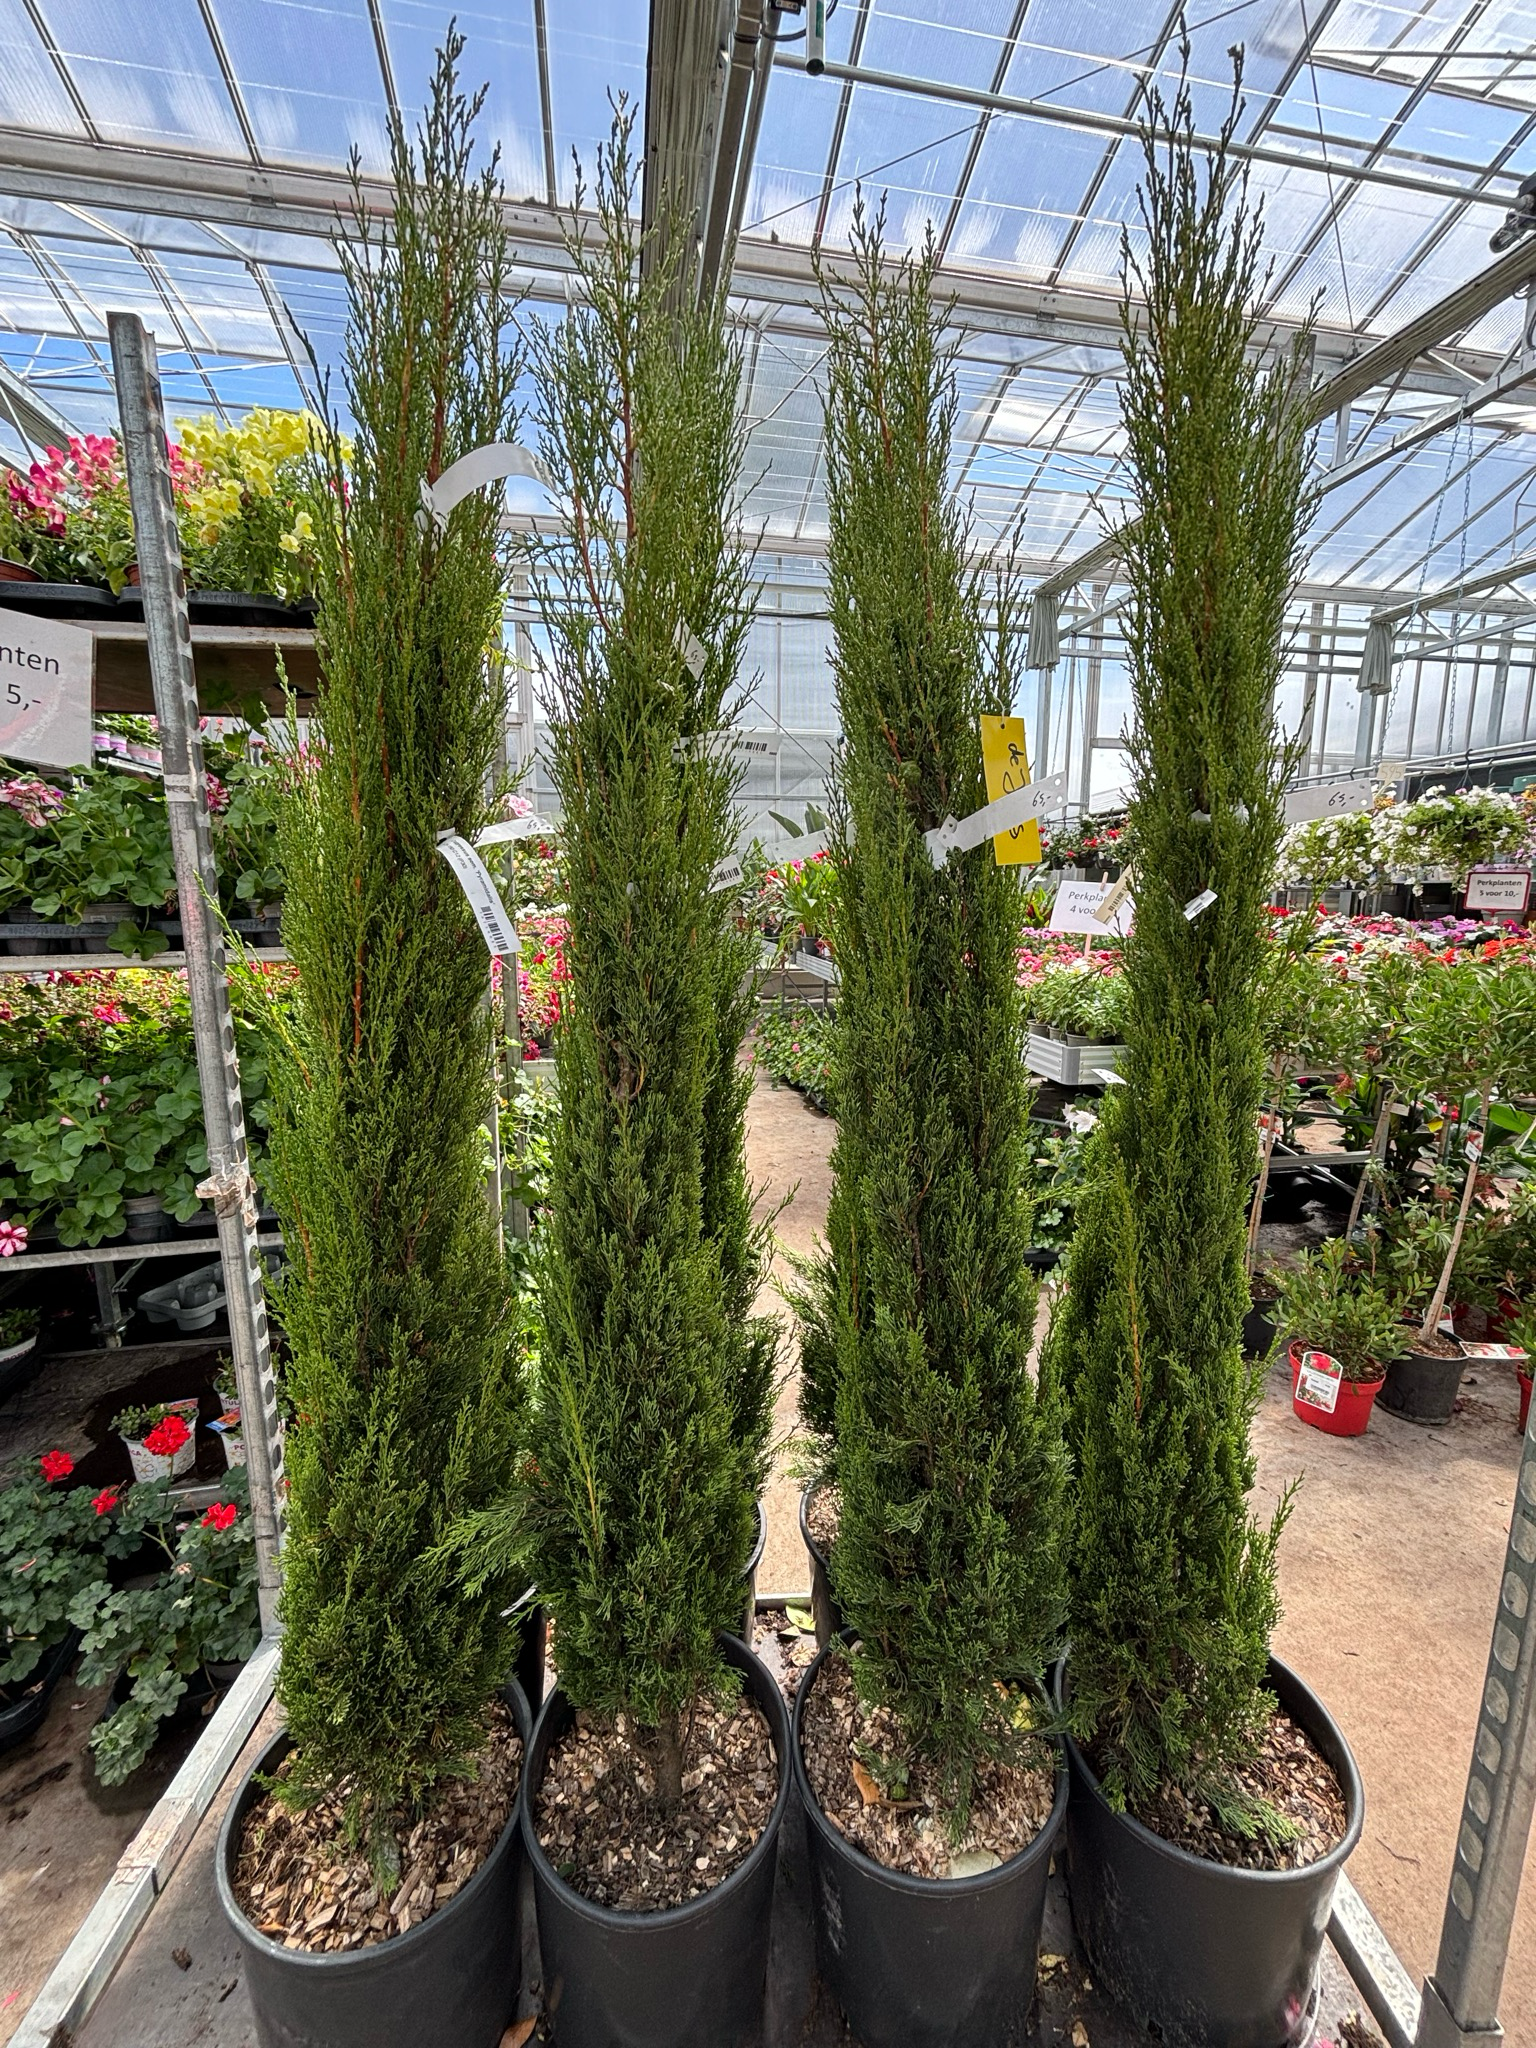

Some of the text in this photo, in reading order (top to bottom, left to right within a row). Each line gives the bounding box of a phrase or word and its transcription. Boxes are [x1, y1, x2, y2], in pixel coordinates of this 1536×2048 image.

[6, 684, 41, 711] 5,-
[1032, 790, 1051, 807] 65,-
[1328, 791, 1355, 807] 65,-
[1477, 879, 1522, 887] Perkplanten
[1070, 905, 1076, 913] 4
